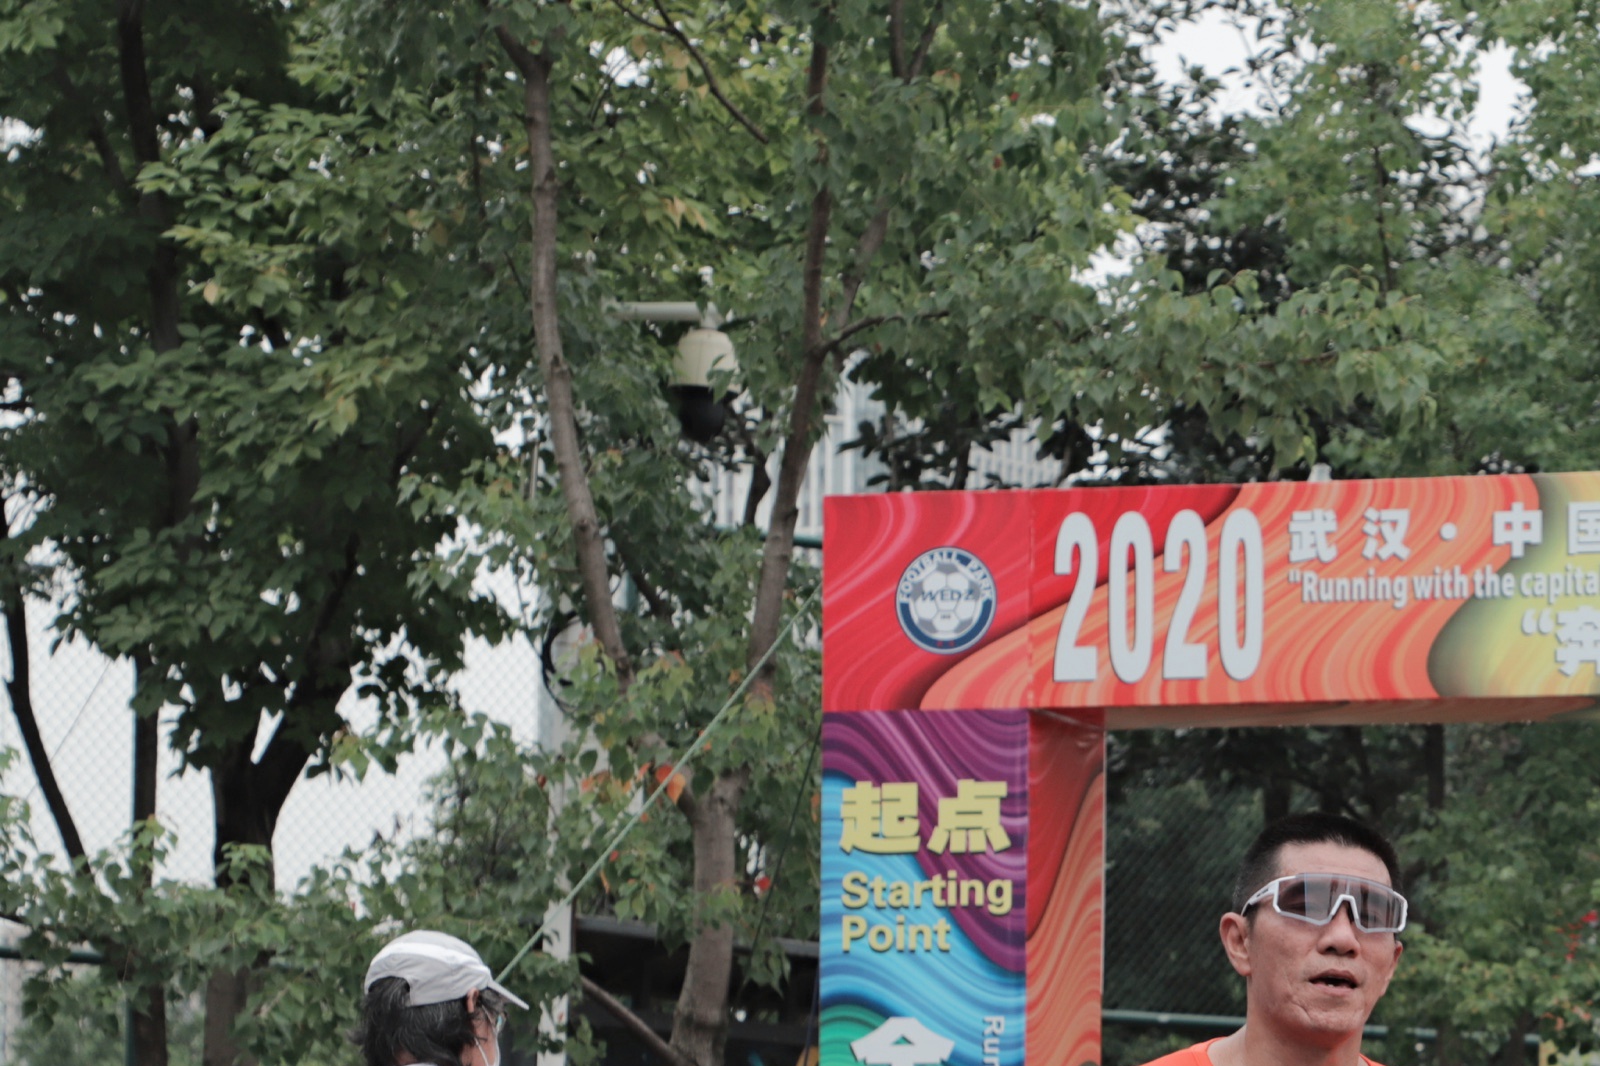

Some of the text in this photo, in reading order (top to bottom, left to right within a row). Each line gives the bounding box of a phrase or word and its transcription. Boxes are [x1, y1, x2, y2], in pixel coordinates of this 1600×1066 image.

[1053, 508, 1264, 684] 2020
[1413, 566, 1468, 598] with
[1474, 565, 1516, 597] the
[839, 779, 1012, 853] 起点
[841, 871, 1013, 915] Starting
[841, 915, 952, 952] Point
